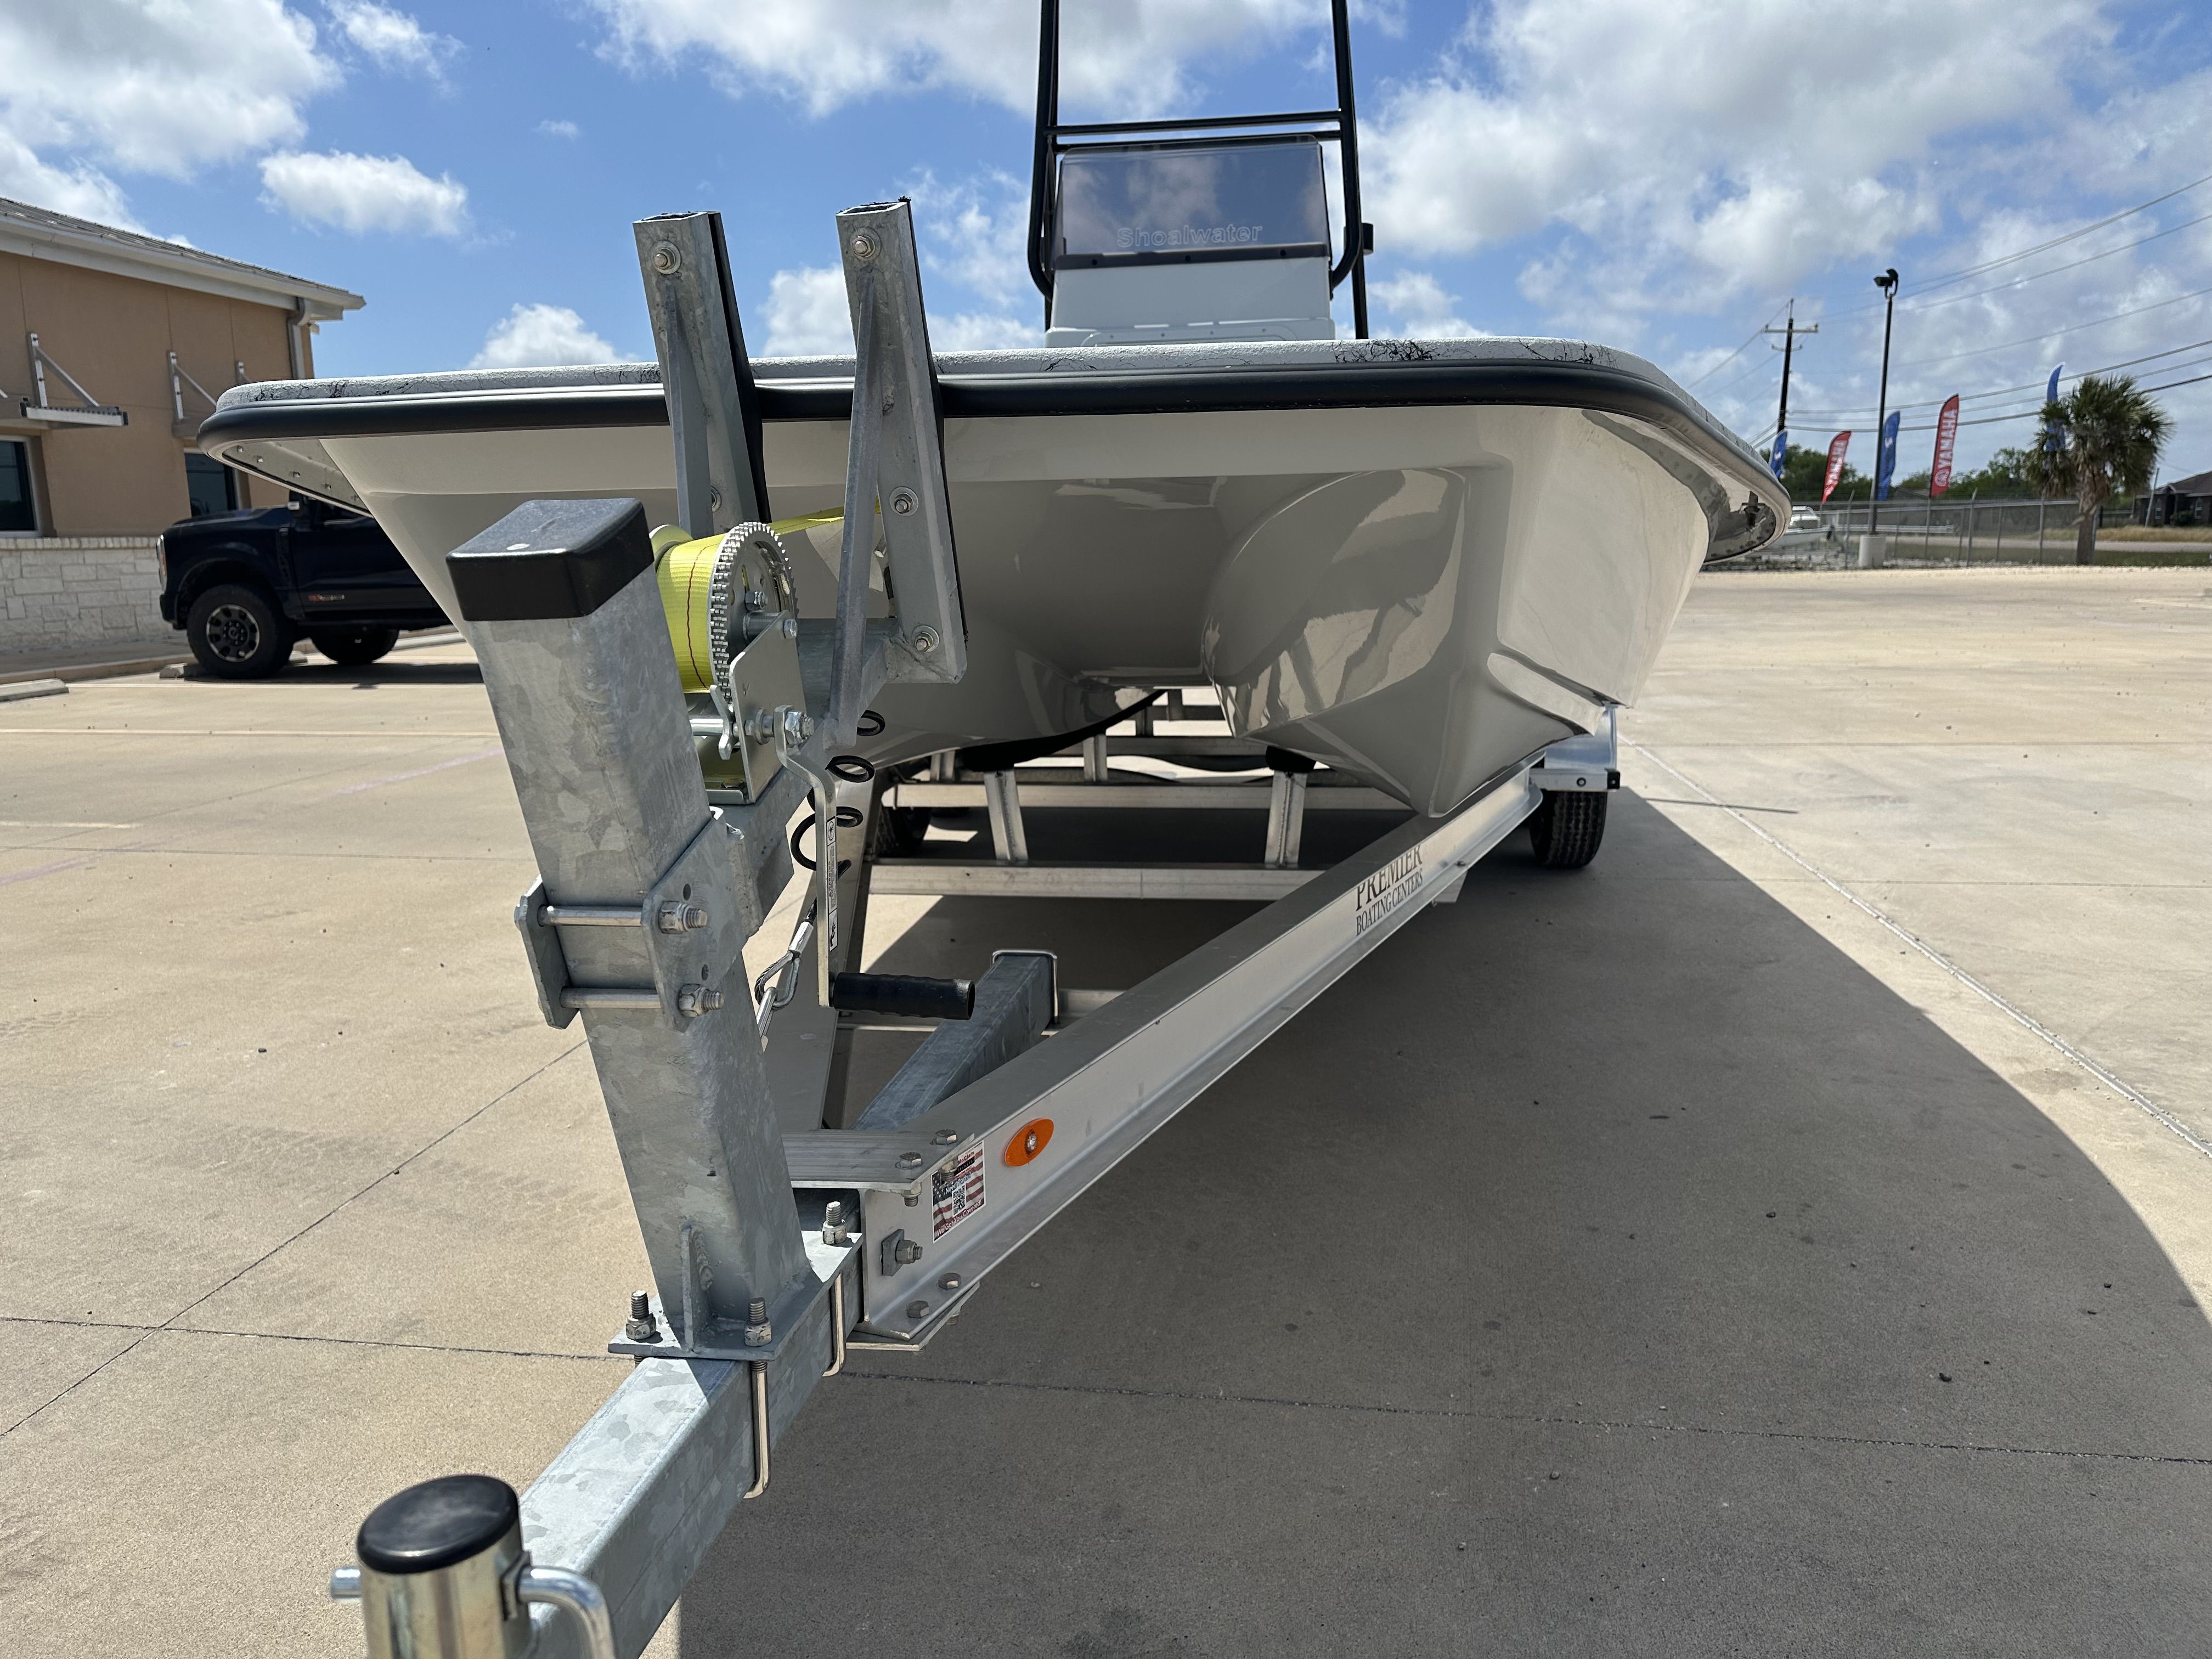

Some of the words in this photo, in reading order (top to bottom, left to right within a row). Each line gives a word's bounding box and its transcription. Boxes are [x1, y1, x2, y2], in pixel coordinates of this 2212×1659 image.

[1117, 223, 1262, 247] Shoalwater
[1938, 409, 1957, 469] YAMAHA
[1356, 845, 1423, 912] PREMIER
[1356, 892, 1392, 936] BOATING
[1392, 868, 1423, 907] CENTERS
[945, 1181, 957, 1195] Need
[937, 1227, 944, 1237] We
[945, 1221, 954, 1230] Got
[954, 1215, 963, 1223] You
